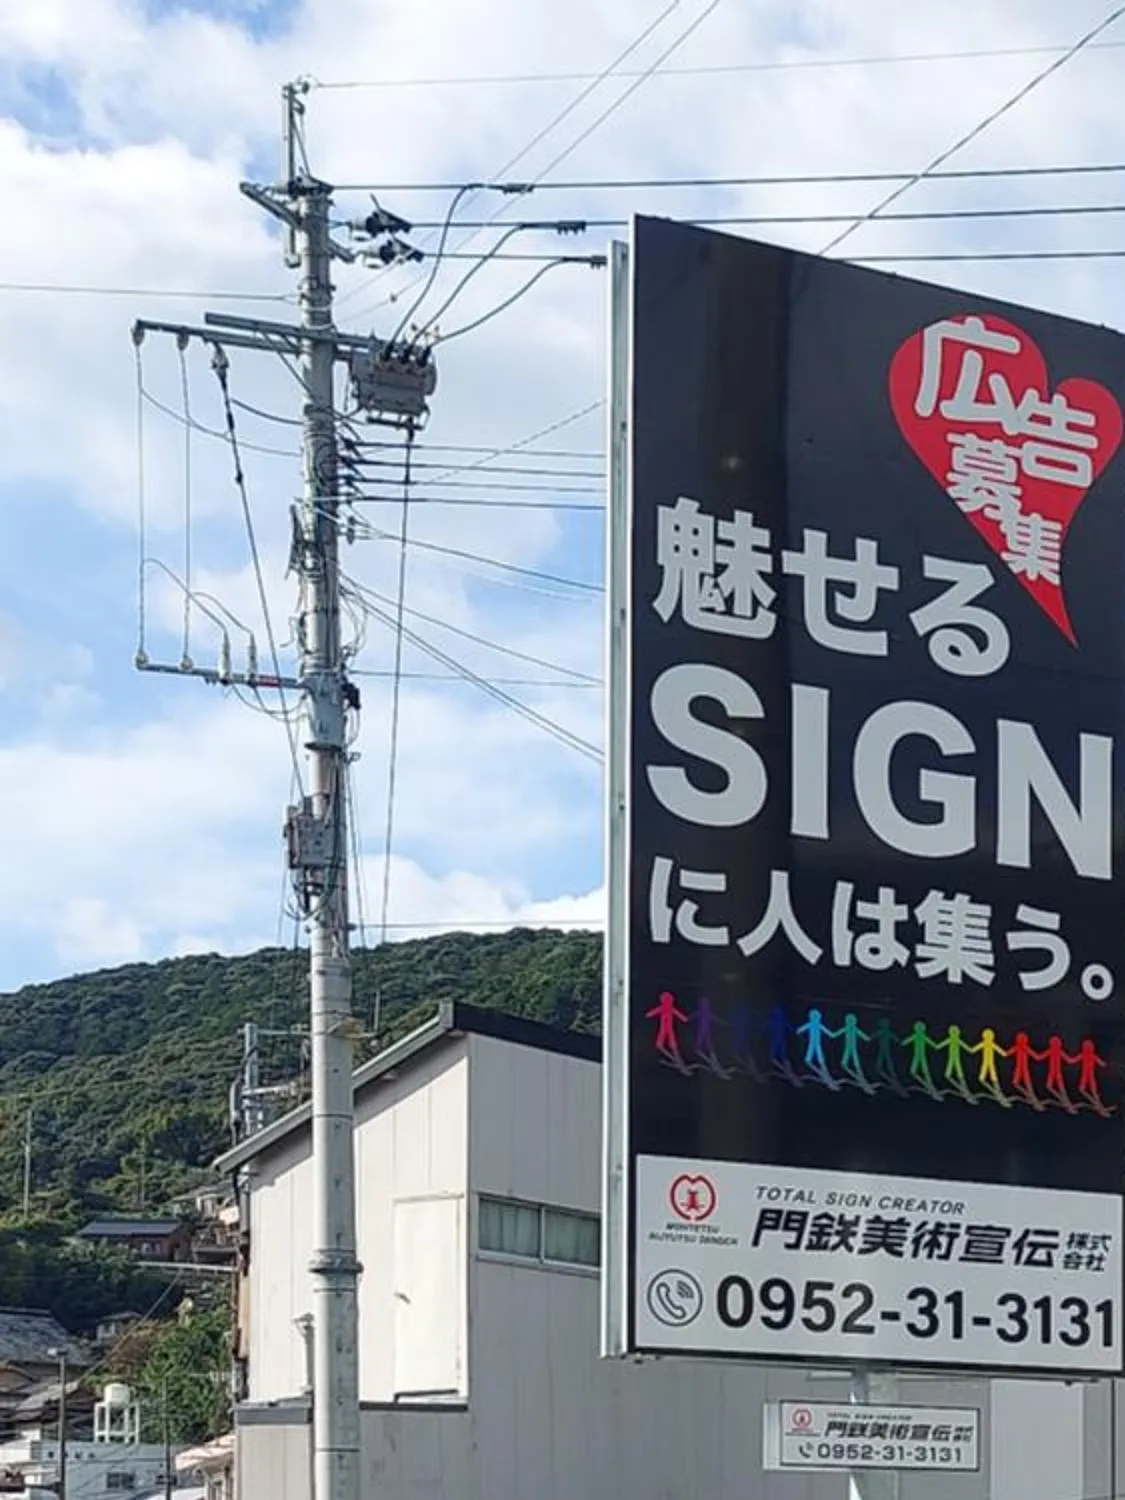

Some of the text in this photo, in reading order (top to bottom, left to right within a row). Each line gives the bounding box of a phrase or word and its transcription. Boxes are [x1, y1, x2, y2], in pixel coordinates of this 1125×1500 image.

[914, 316, 1099, 488] 広告
[945, 432, 1063, 585] 募集
[652, 496, 1011, 678] 魅せる
[645, 662, 1115, 881] SIGN
[649, 856, 1115, 1001] に人は集う。
[755, 1185, 966, 1215] TOTAL SIGN CREATOR
[715, 1274, 1116, 1349] 0952-31-3131
[817, 1443, 962, 1463] 0952-31-3131
